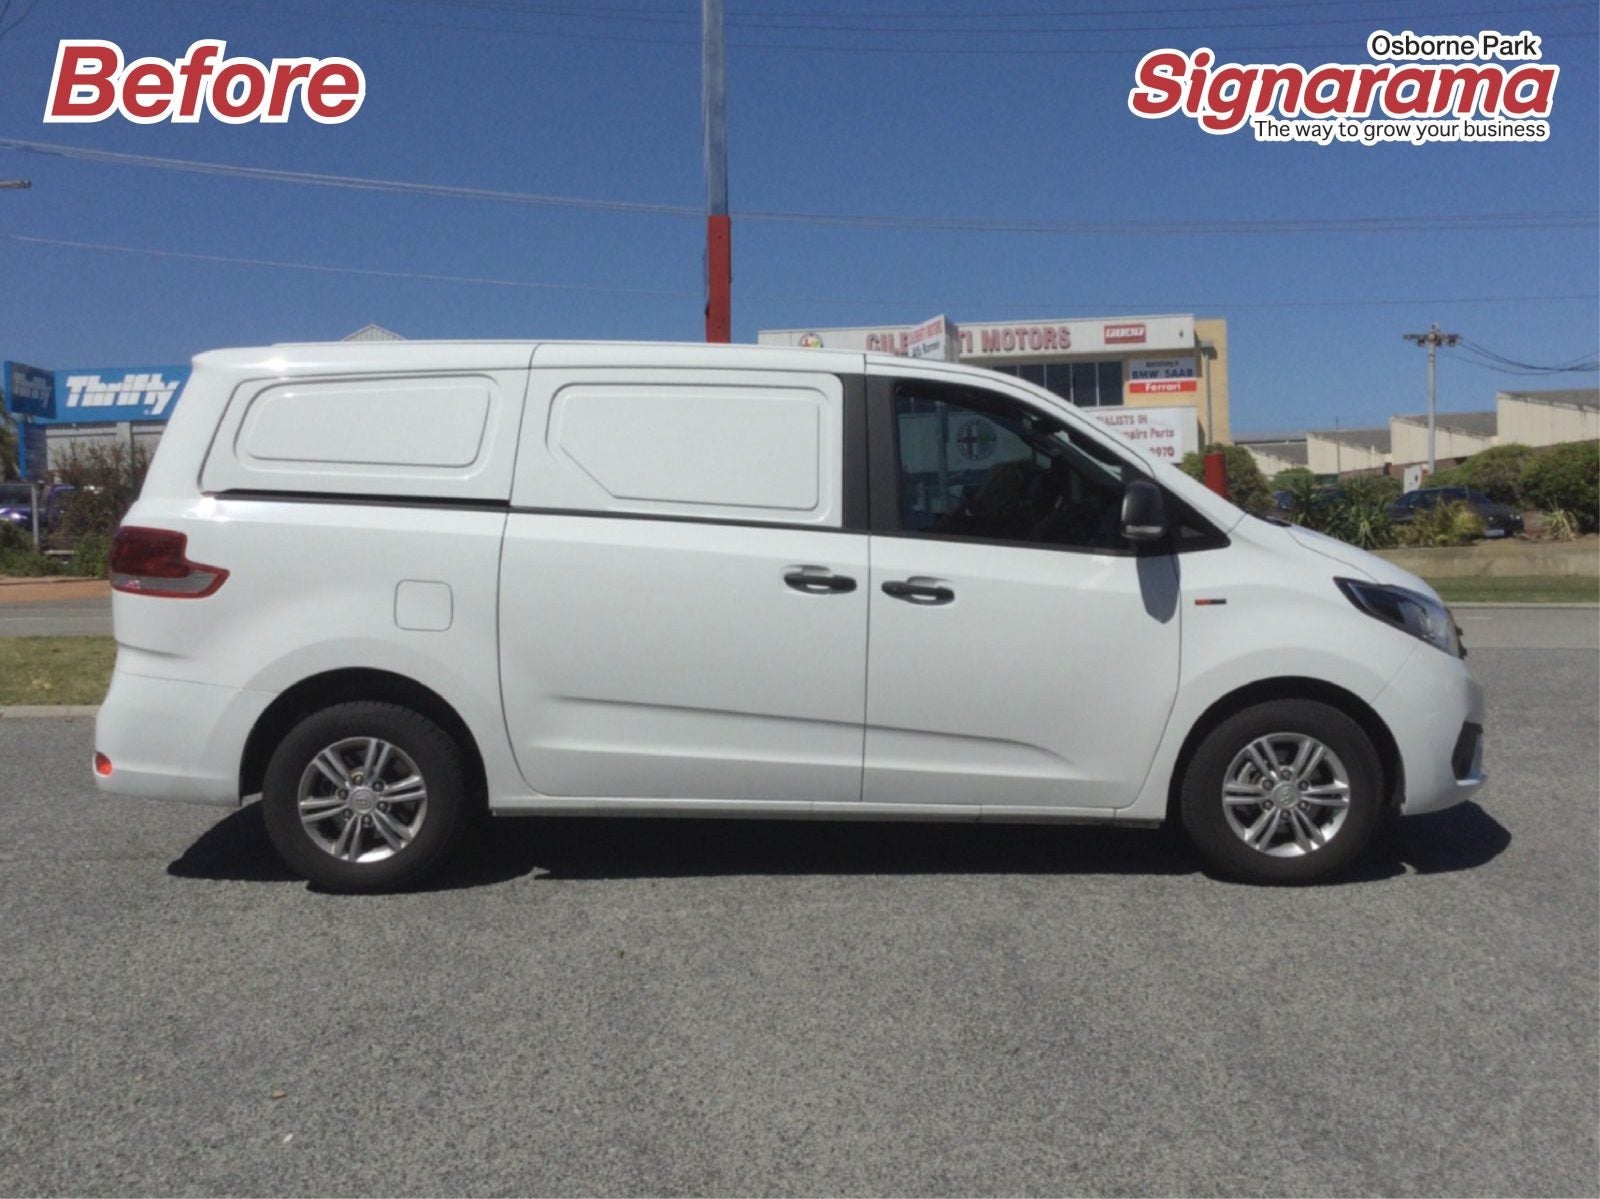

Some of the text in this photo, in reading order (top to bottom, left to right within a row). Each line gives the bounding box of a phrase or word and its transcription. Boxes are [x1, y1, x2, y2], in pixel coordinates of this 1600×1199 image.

[1105, 326, 1145, 338] FIAT
[981, 326, 1071, 353] MOTORS
[1131, 368, 1194, 379] BMW SAAB
[1144, 382, 1182, 392] Ferrari
[65, 373, 181, 415] Thrifty
[1150, 427, 1175, 438] Parts
